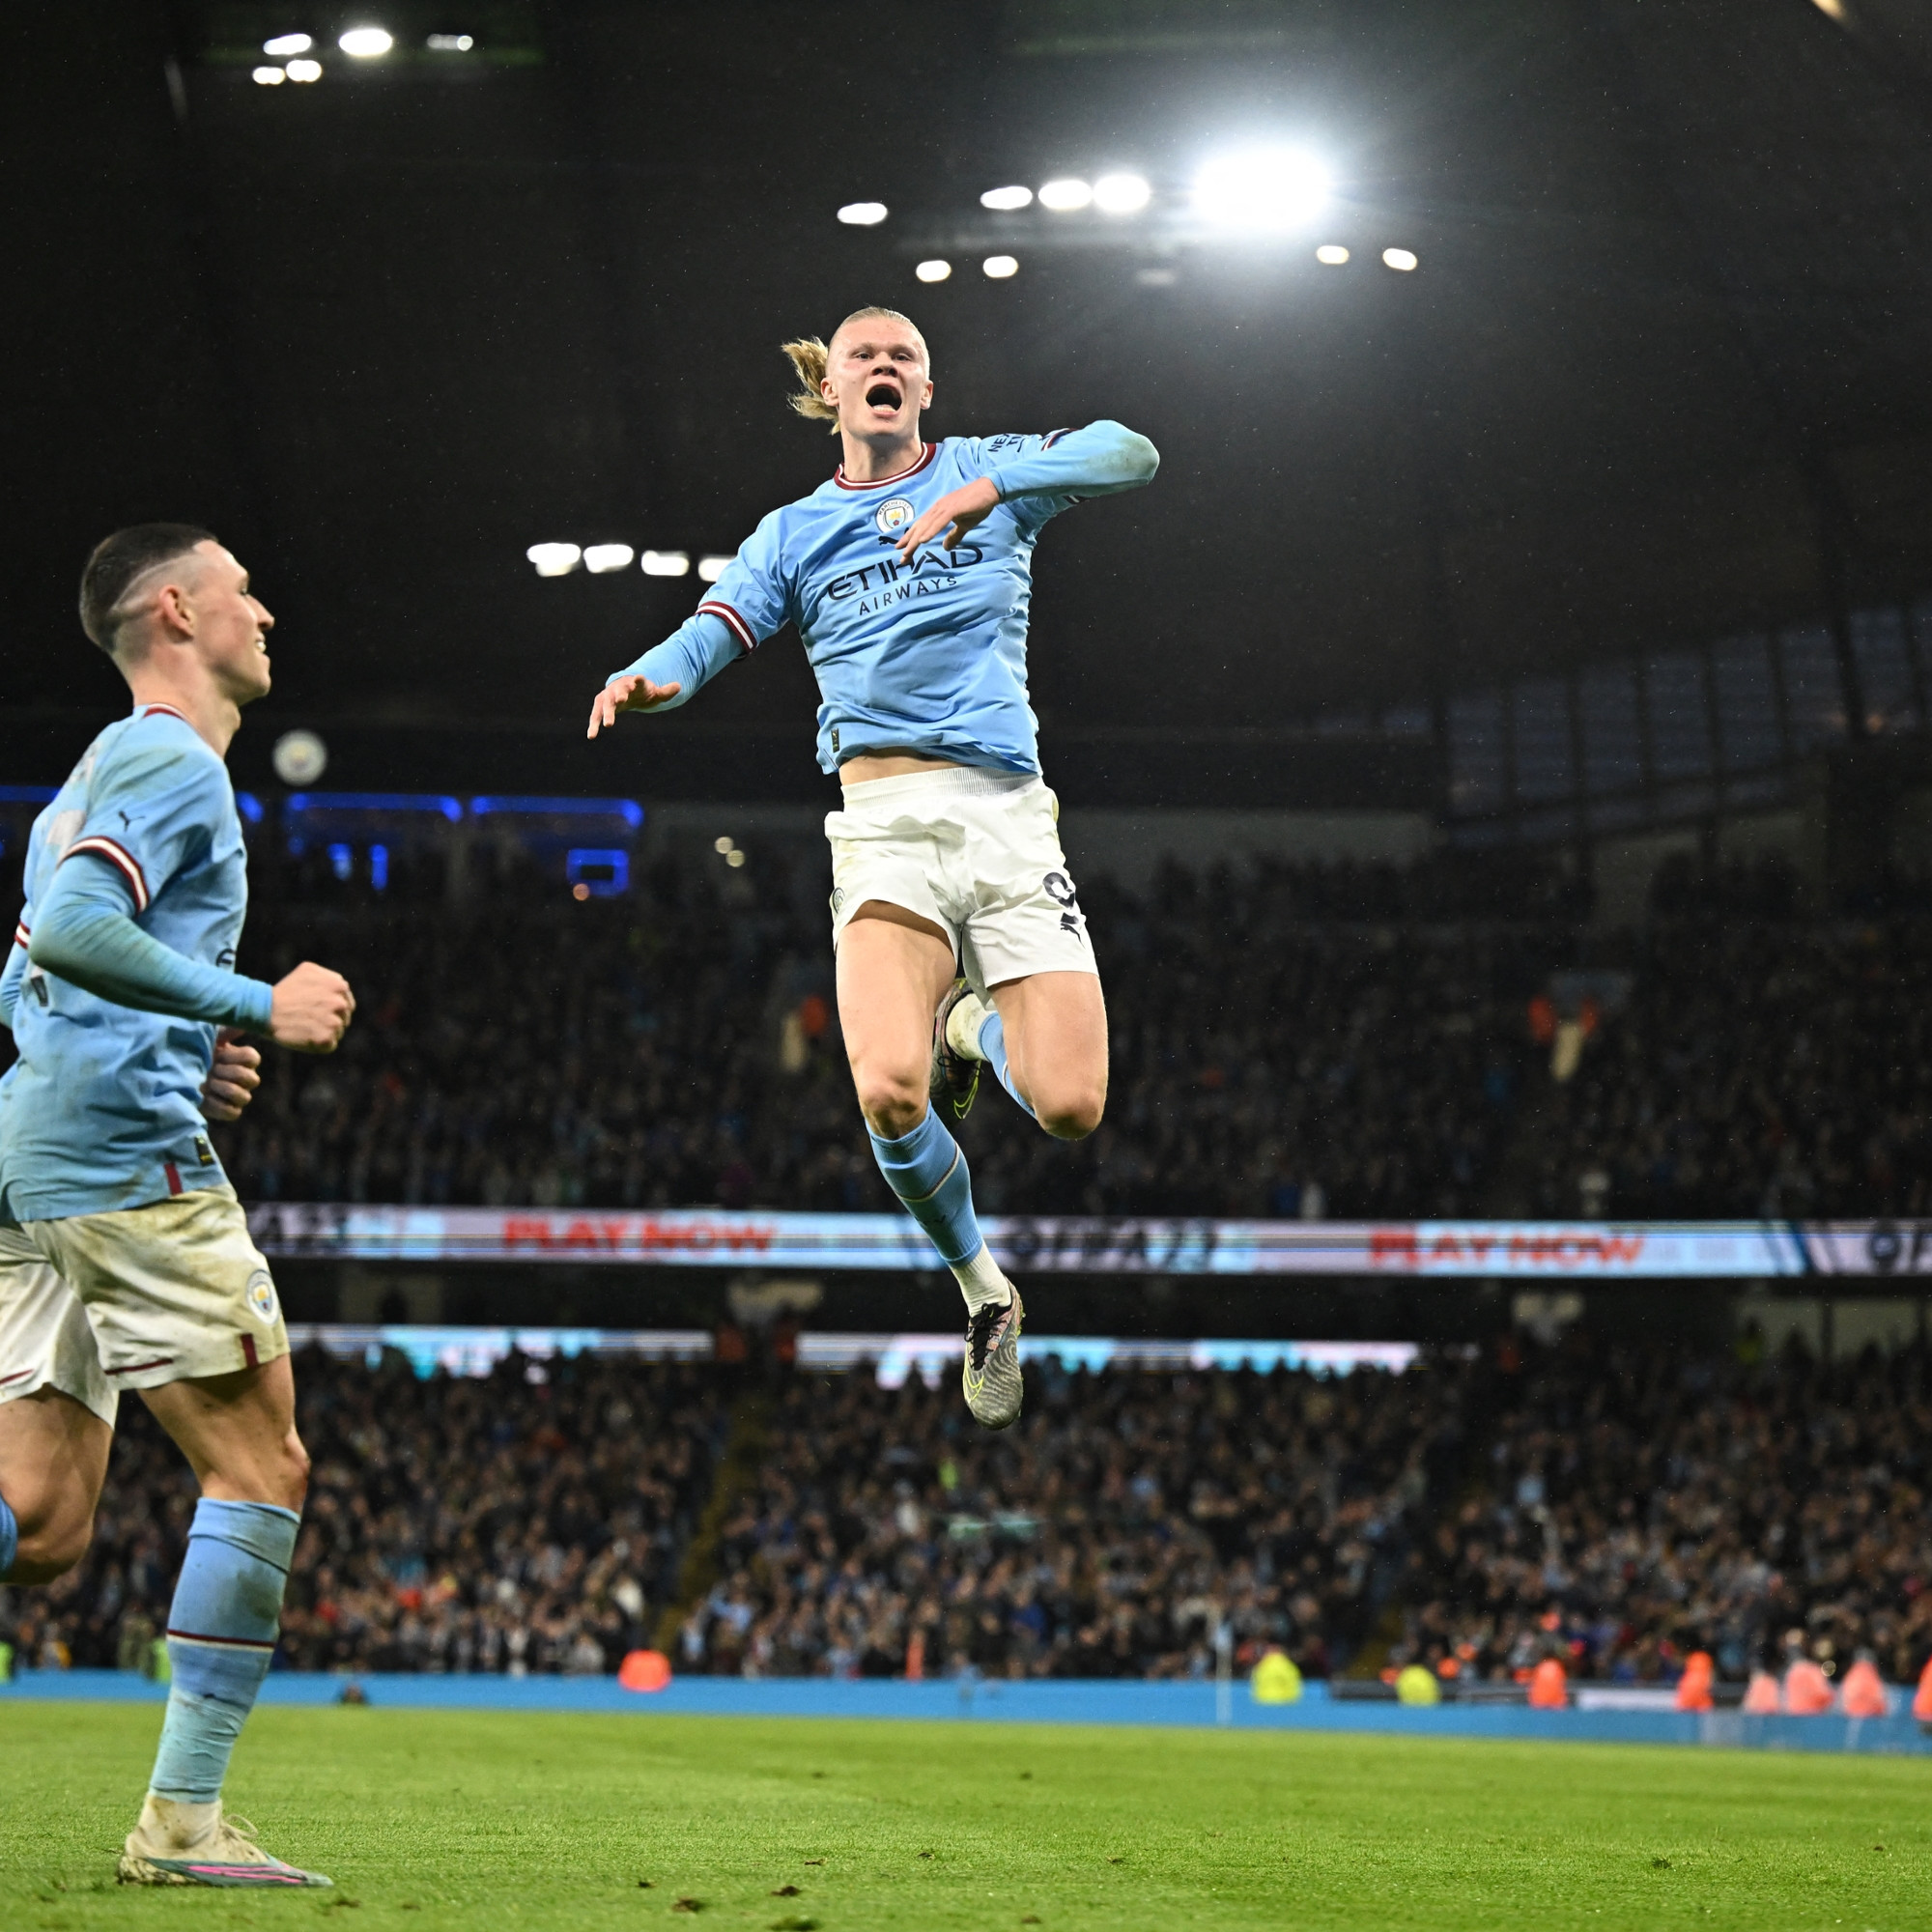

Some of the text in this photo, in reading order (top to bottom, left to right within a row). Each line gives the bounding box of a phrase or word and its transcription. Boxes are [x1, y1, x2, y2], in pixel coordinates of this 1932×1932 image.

[827, 545, 983, 601] ETIHAD
[859, 576, 957, 615] AIRWAYS
[641, 1218, 776, 1254] NOW
[1508, 1231, 1644, 1267] NOW
